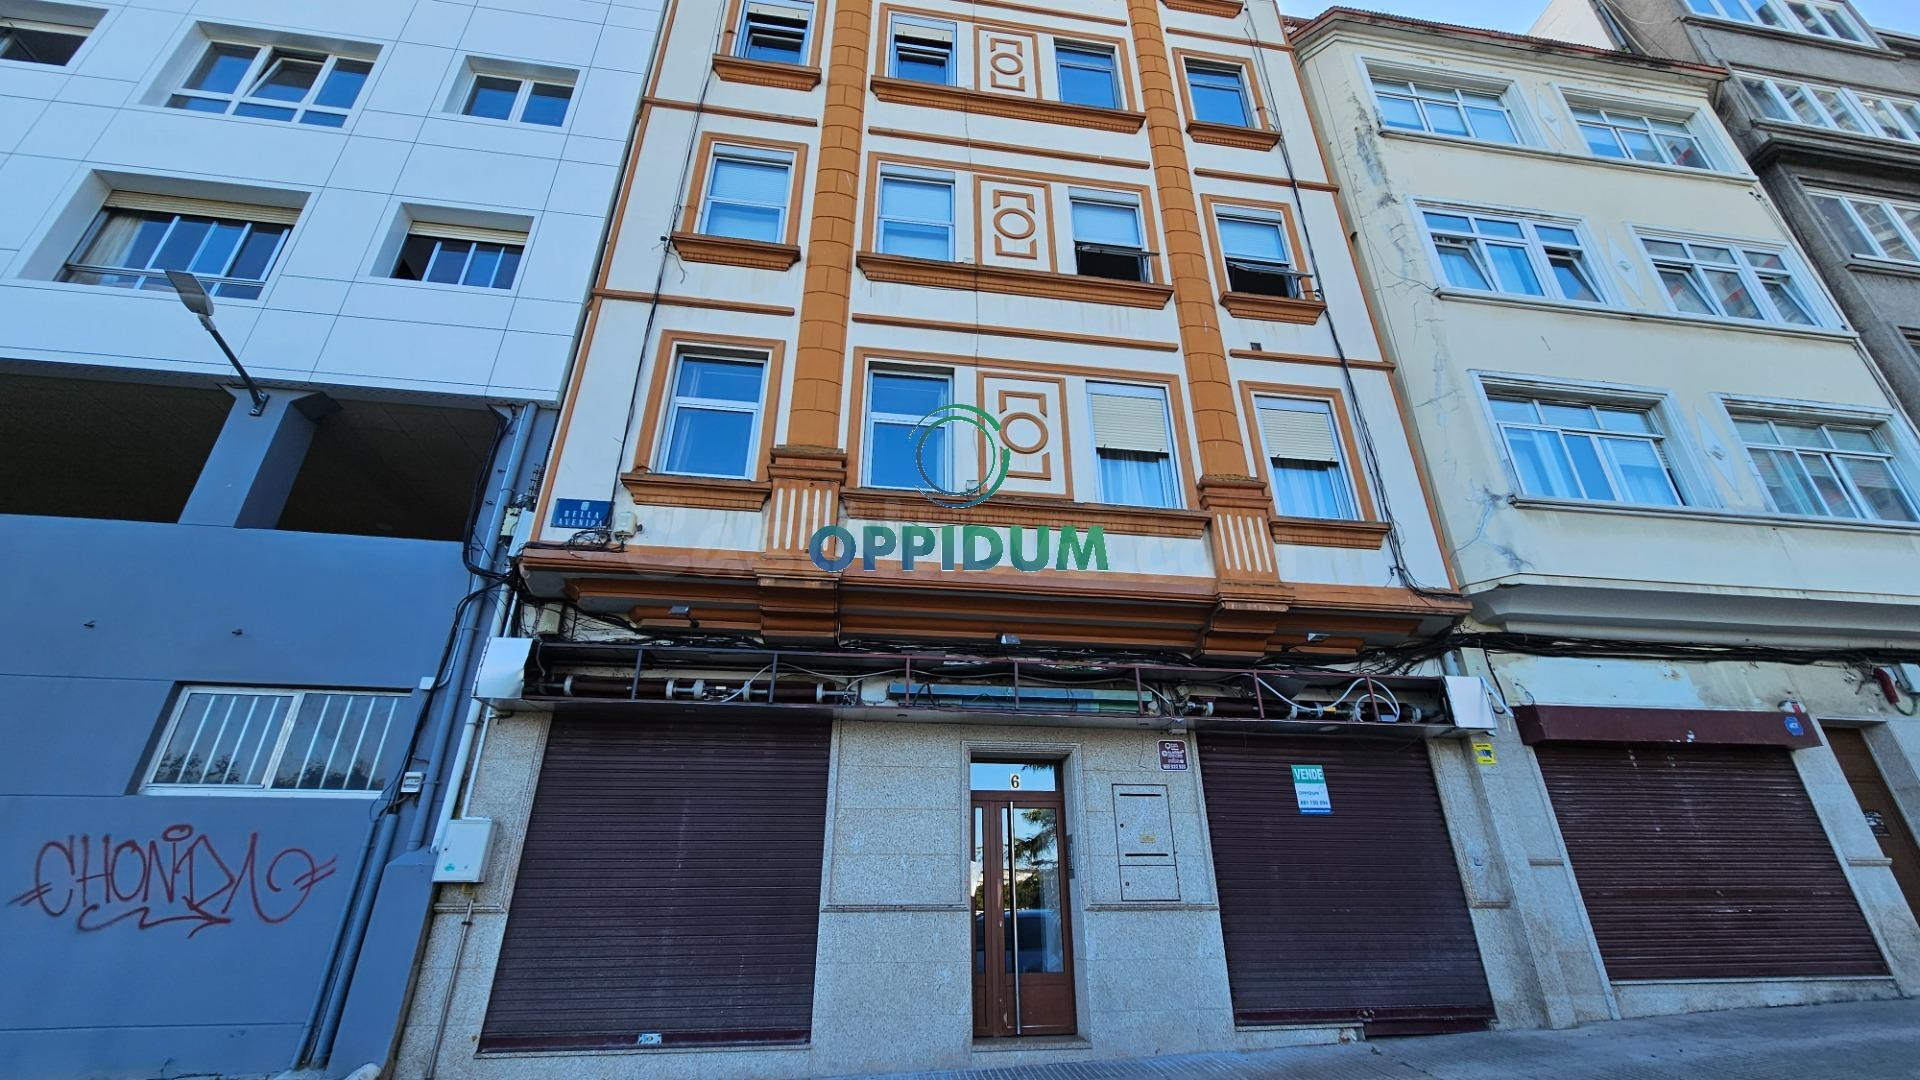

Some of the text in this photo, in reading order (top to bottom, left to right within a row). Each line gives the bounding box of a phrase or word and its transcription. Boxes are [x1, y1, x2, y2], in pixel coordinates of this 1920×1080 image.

[564, 510, 600, 519] BELLA
[1293, 768, 1324, 780] VENDE
[1011, 775, 1020, 789] 6
